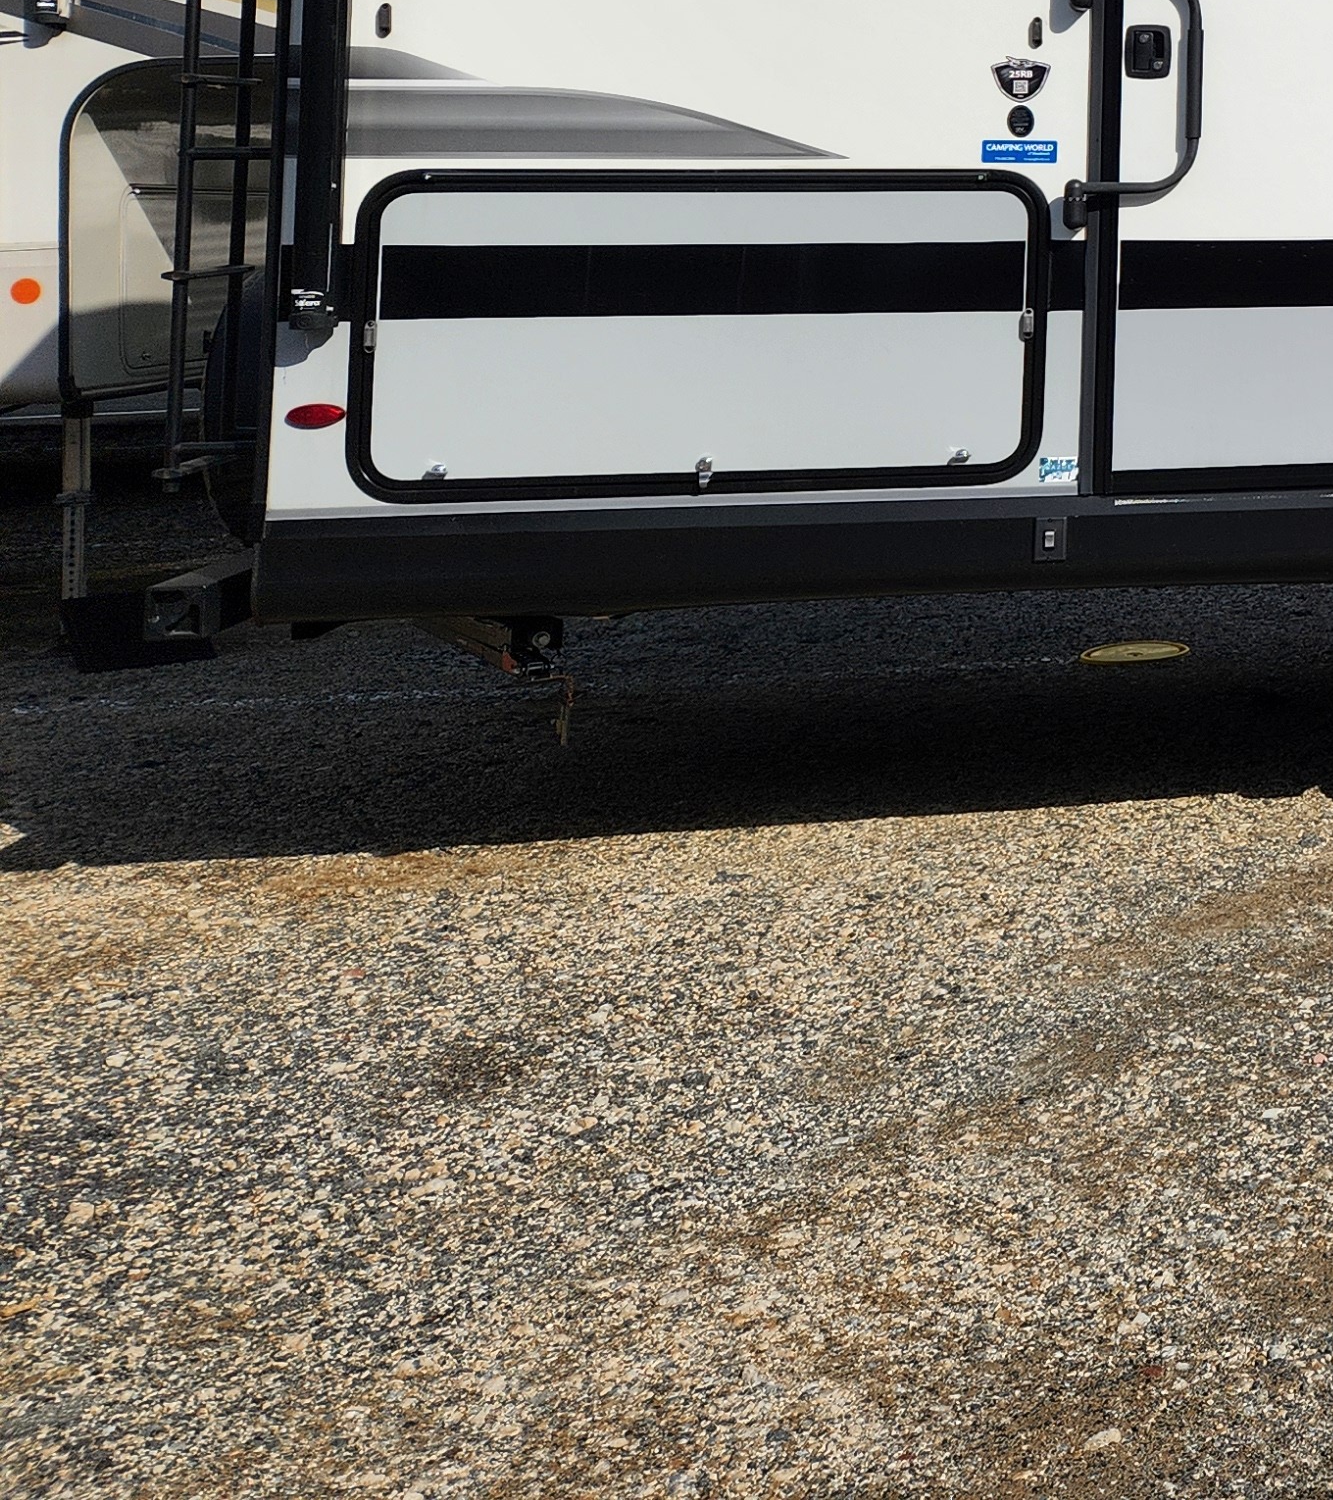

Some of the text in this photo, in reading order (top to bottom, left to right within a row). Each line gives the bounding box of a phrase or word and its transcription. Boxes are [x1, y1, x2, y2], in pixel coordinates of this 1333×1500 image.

[1009, 70, 1033, 78] 25RB
[986, 144, 1054, 152] CAMPING WORLD
